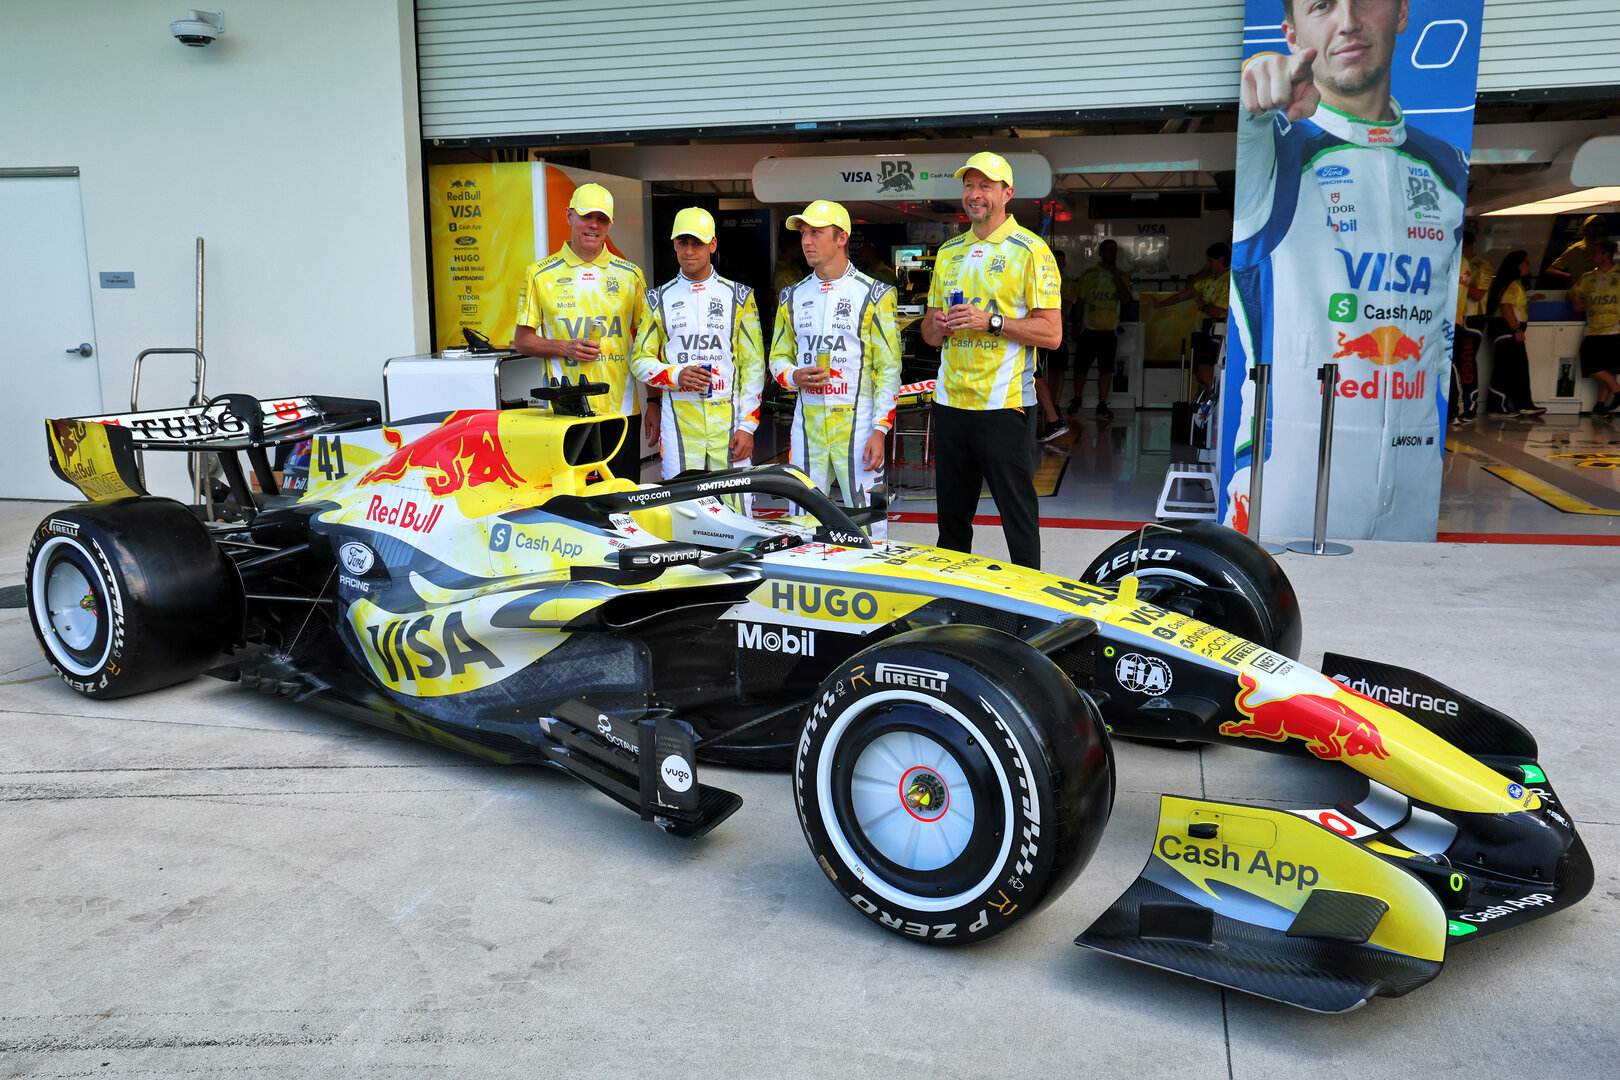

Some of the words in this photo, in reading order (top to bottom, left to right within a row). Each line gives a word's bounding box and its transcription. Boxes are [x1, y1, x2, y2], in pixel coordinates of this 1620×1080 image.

[840, 171, 872, 183] VISA
[1407, 166, 1430, 178] VISA
[447, 191, 464, 201] Red
[464, 190, 481, 201] Bull
[448, 205, 482, 218] VISA
[1137, 223, 1167, 234] VISA
[1407, 227, 1444, 241] HUGO
[1015, 232, 1034, 245] HUGO
[454, 254, 480, 262] HUGO
[537, 256, 558, 268] HUGO
[614, 258, 637, 269] HUGO
[1334, 248, 1432, 295] VISA
[1590, 295, 1618, 305] VISA
[1409, 305, 1433, 324] App
[677, 334, 723, 350] VISA
[805, 335, 847, 351] VISA
[951, 337, 973, 348] Cash
[975, 339, 999, 350] App
[1461, 338, 1475, 384] HUGO
[711, 379, 725, 391] ull
[825, 382, 848, 395] Bull
[1392, 371, 1426, 400] Bull
[131, 410, 274, 439] TUDO
[1392, 436, 1423, 447] LAWSON
[318, 435, 349, 481] 41
[282, 476, 307, 490] Mobil
[696, 477, 751, 492] XMTRADING
[627, 490, 671, 506] yugo.com
[366, 495, 403, 526] Red
[399, 501, 444, 534] Bull
[612, 517, 635, 526] Mobil
[49, 518, 80, 537] PIRELLI
[515, 532, 549, 553] Cash
[551, 537, 583, 558] App
[848, 535, 864, 544] DOT
[347, 549, 368, 571] Ford
[662, 550, 701, 562] hahnair
[1094, 548, 1178, 582] ZERO
[339, 575, 370, 592] RACING
[772, 582, 878, 621] HUGO
[1041, 581, 1118, 607] 41
[366, 610, 505, 683] VISA
[737, 622, 815, 657] Mobil
[1257, 655, 1280, 671] NEFT
[875, 662, 949, 693] PIRELLI
[1351, 678, 1459, 717] dynatrace
[606, 733, 640, 755] OCTAVE
[665, 767, 690, 783] yugo
[1158, 834, 1241, 872] Cash
[1247, 849, 1320, 890] App
[850, 893, 958, 939] ZERO
[1460, 903, 1508, 925] Cash
[1507, 891, 1554, 912] App
[968, 909, 990, 934] P
